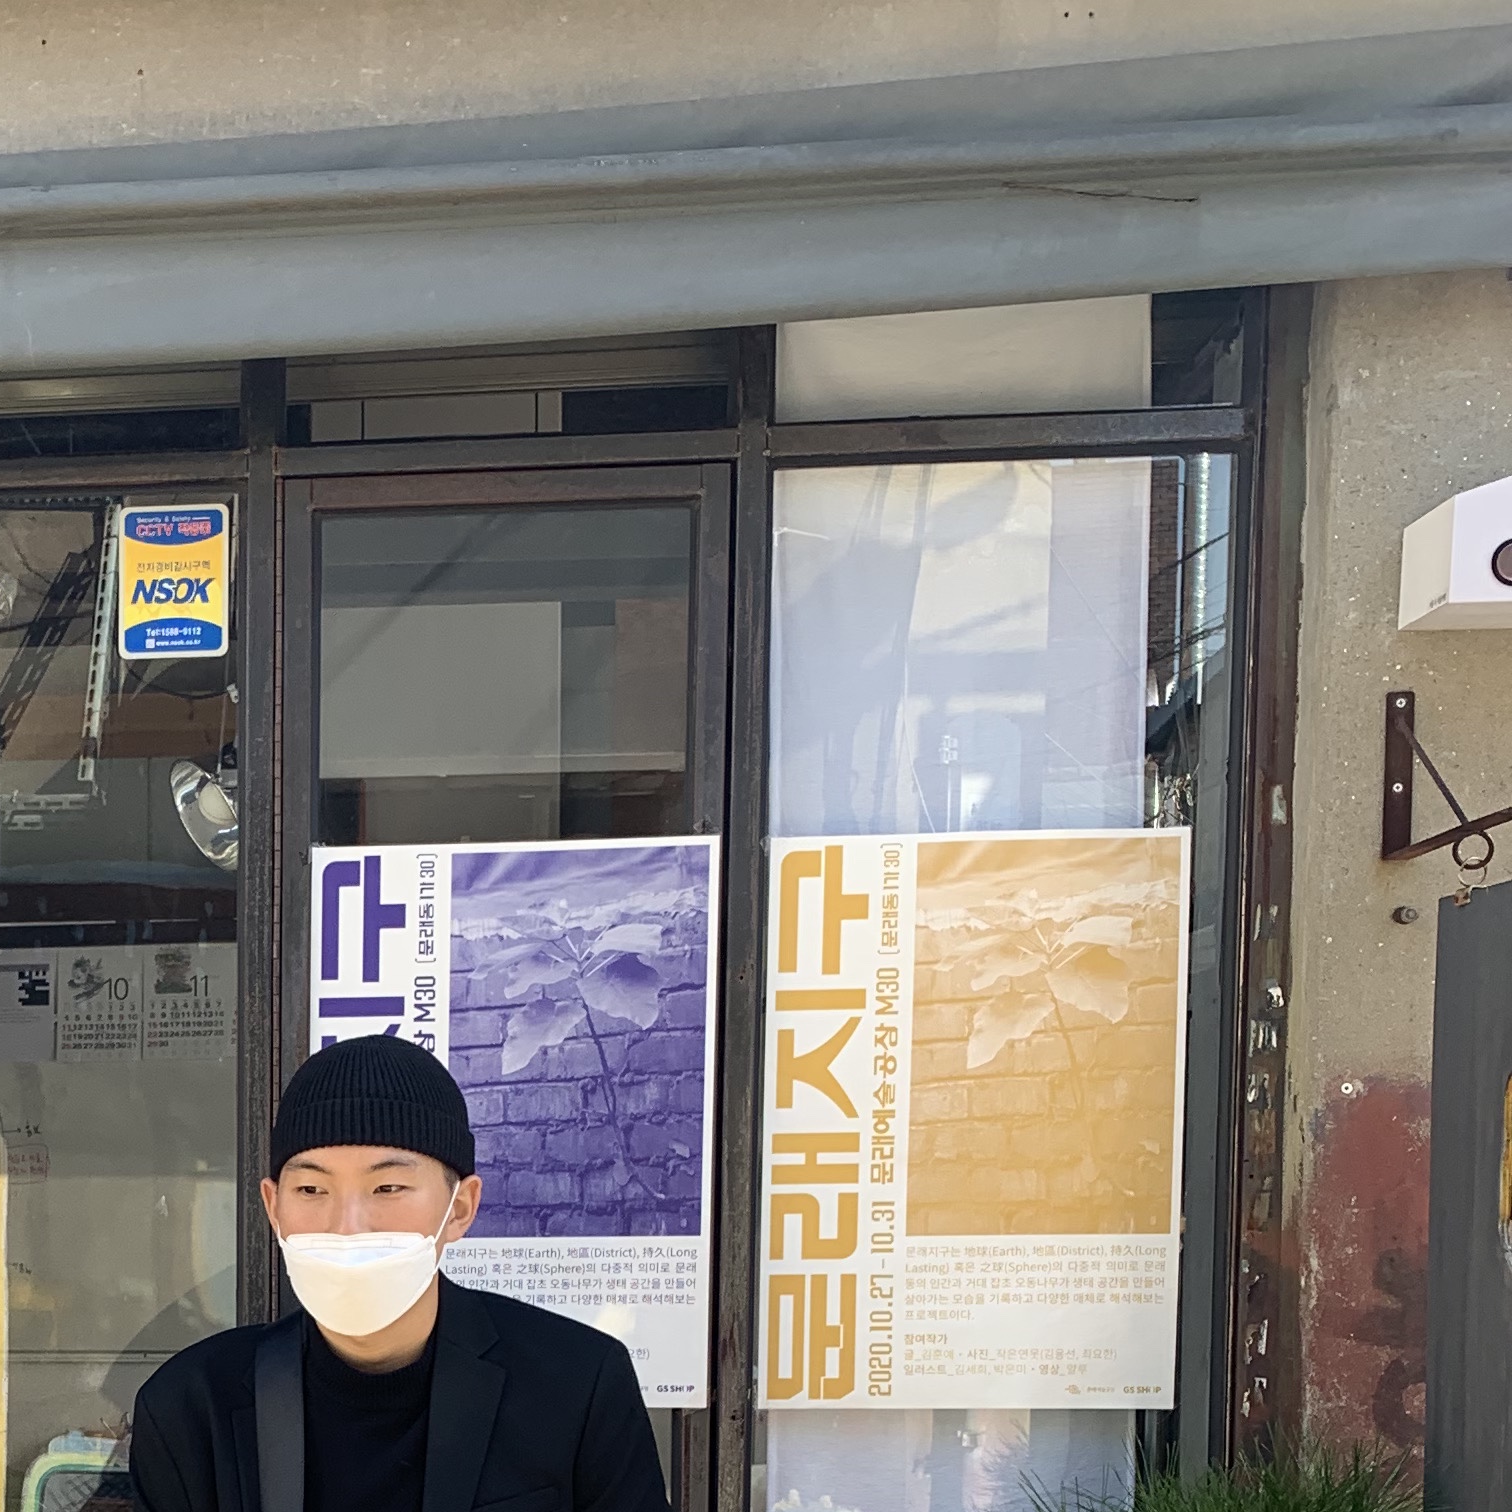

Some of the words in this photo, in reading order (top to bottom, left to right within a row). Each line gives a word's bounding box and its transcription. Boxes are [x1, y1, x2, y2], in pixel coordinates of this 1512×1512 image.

[131, 577, 216, 604] NSOK
[104, 977, 129, 1000] 10
[190, 975, 209, 997] 11
[874, 967, 900, 1016] M30
[413, 976, 436, 1022] M30
[870, 1022, 899, 1186] 문래예술공장
[767, 845, 869, 1400] 문래지구
[445, 1248, 498, 1259] 문래지구는
[906, 1247, 962, 1258] 문래지구는
[445, 1264, 487, 1276] Lasting)
[491, 1264, 511, 1275] 혹은
[601, 1263, 633, 1275] 다중적
[638, 1262, 670, 1274] 의미로
[675, 1262, 697, 1274] 문래
[905, 1262, 949, 1275] Lasting)
[953, 1262, 975, 1273] 혹은
[1106, 1261, 1139, 1273] 의미로
[1144, 1261, 1166, 1273] 문래
[502, 1279, 523, 1290] 거대
[526, 1279, 547, 1290] 잡초
[550, 1278, 602, 1290] 오동나무가
[630, 1278, 661, 1290] 공간을
[929, 1278, 962, 1289] 인간과
[966, 1278, 987, 1289] 거대
[1015, 1278, 1069, 1289] 오동나무가
[656, 1385, 669, 1393] GS
[1123, 1386, 1135, 1394] GS
